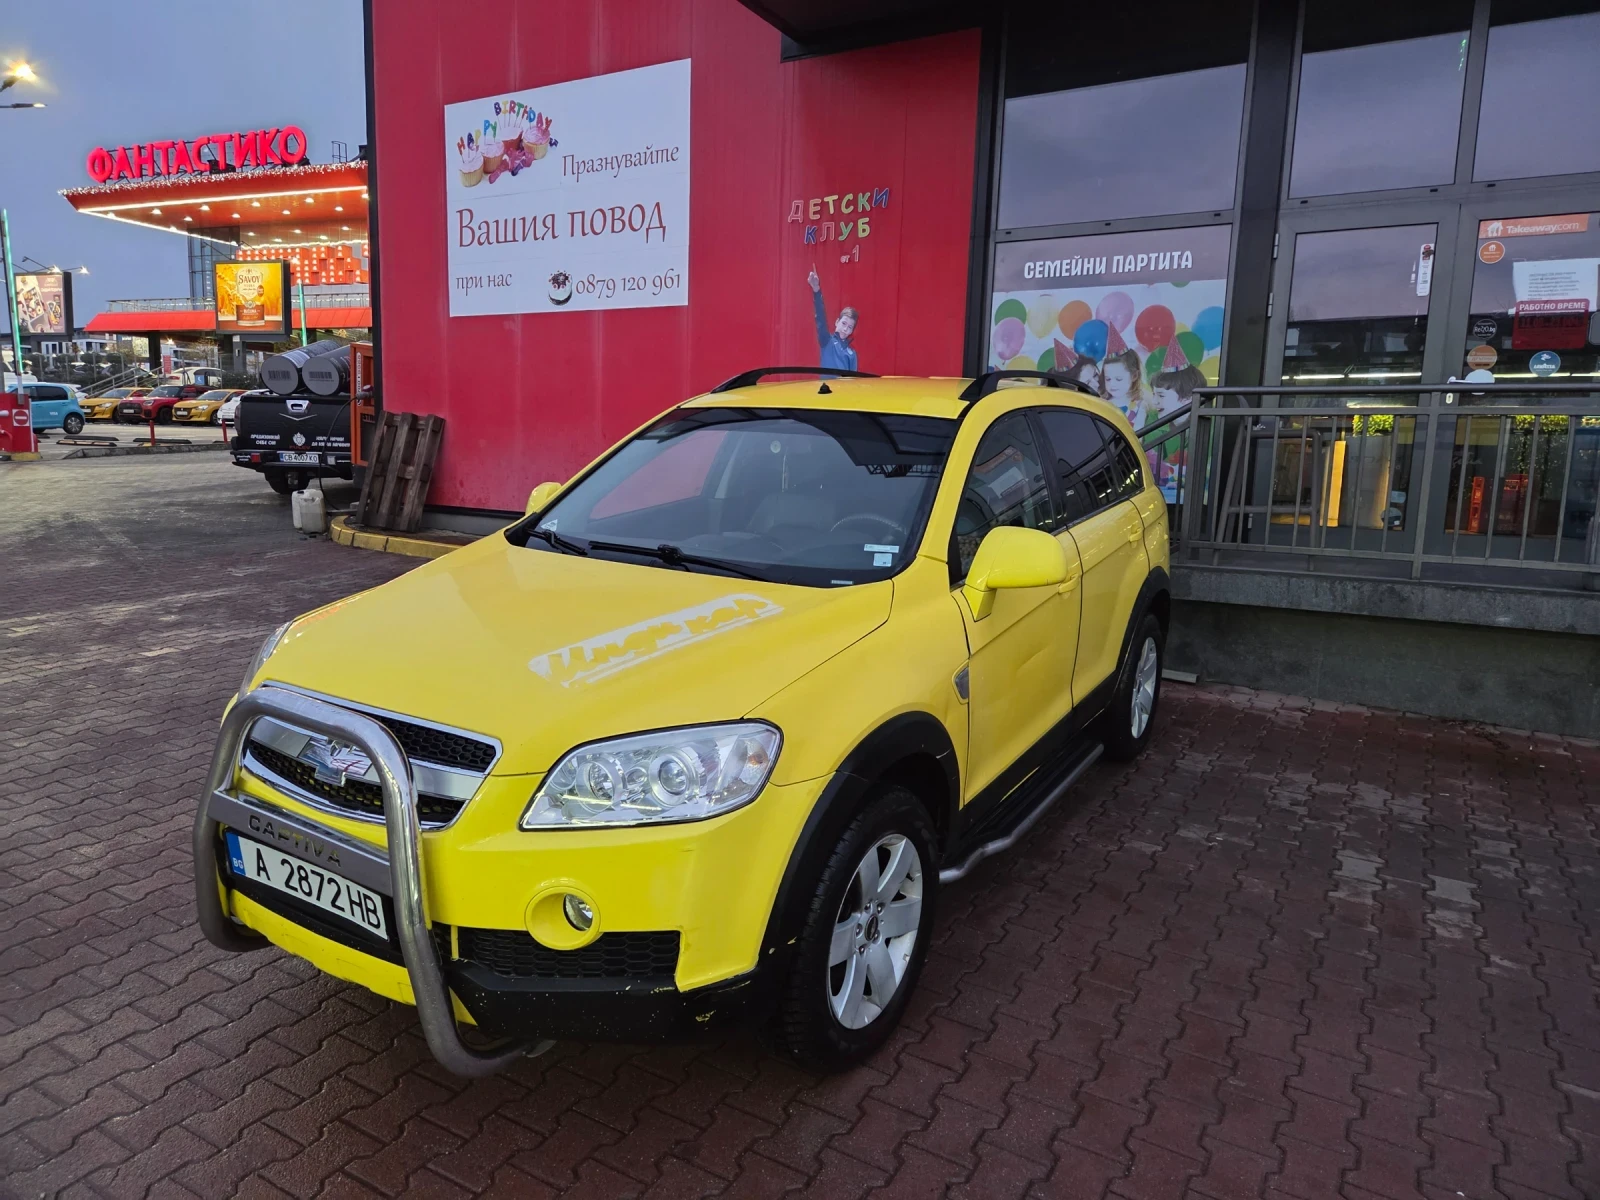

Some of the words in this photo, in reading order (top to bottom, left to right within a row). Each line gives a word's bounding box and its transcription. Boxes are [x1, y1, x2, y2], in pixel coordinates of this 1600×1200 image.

[456, 118, 499, 155] HAPPY
[493, 99, 553, 131] BIRTHDAY
[86, 124, 309, 183] ФАНТАСТИКО
[562, 144, 680, 183] Празнувайте
[787, 187, 890, 223] ДЕТСКИ
[456, 207, 559, 248] Вашия
[567, 201, 667, 243] повод
[804, 217, 871, 245] КЛУБ
[1505, 221, 1580, 235] Takeaway.com
[238, 274, 261, 285] SAVOY
[1023, 255, 1107, 279] СЕМЕЙНИ
[1112, 250, 1194, 274] ПАРТИТА
[456, 275, 484, 297] при
[487, 273, 513, 288] нас
[575, 273, 617, 299] 0879
[621, 275, 647, 293] 120
[652, 268, 681, 296] 961
[1519, 302, 1556, 311] РАБОТНО
[1557, 301, 1586, 310] ВРЕМЕ
[248, 814, 342, 868] CAPTIVA
[232, 857, 244, 869] BG
[256, 847, 271, 881] A
